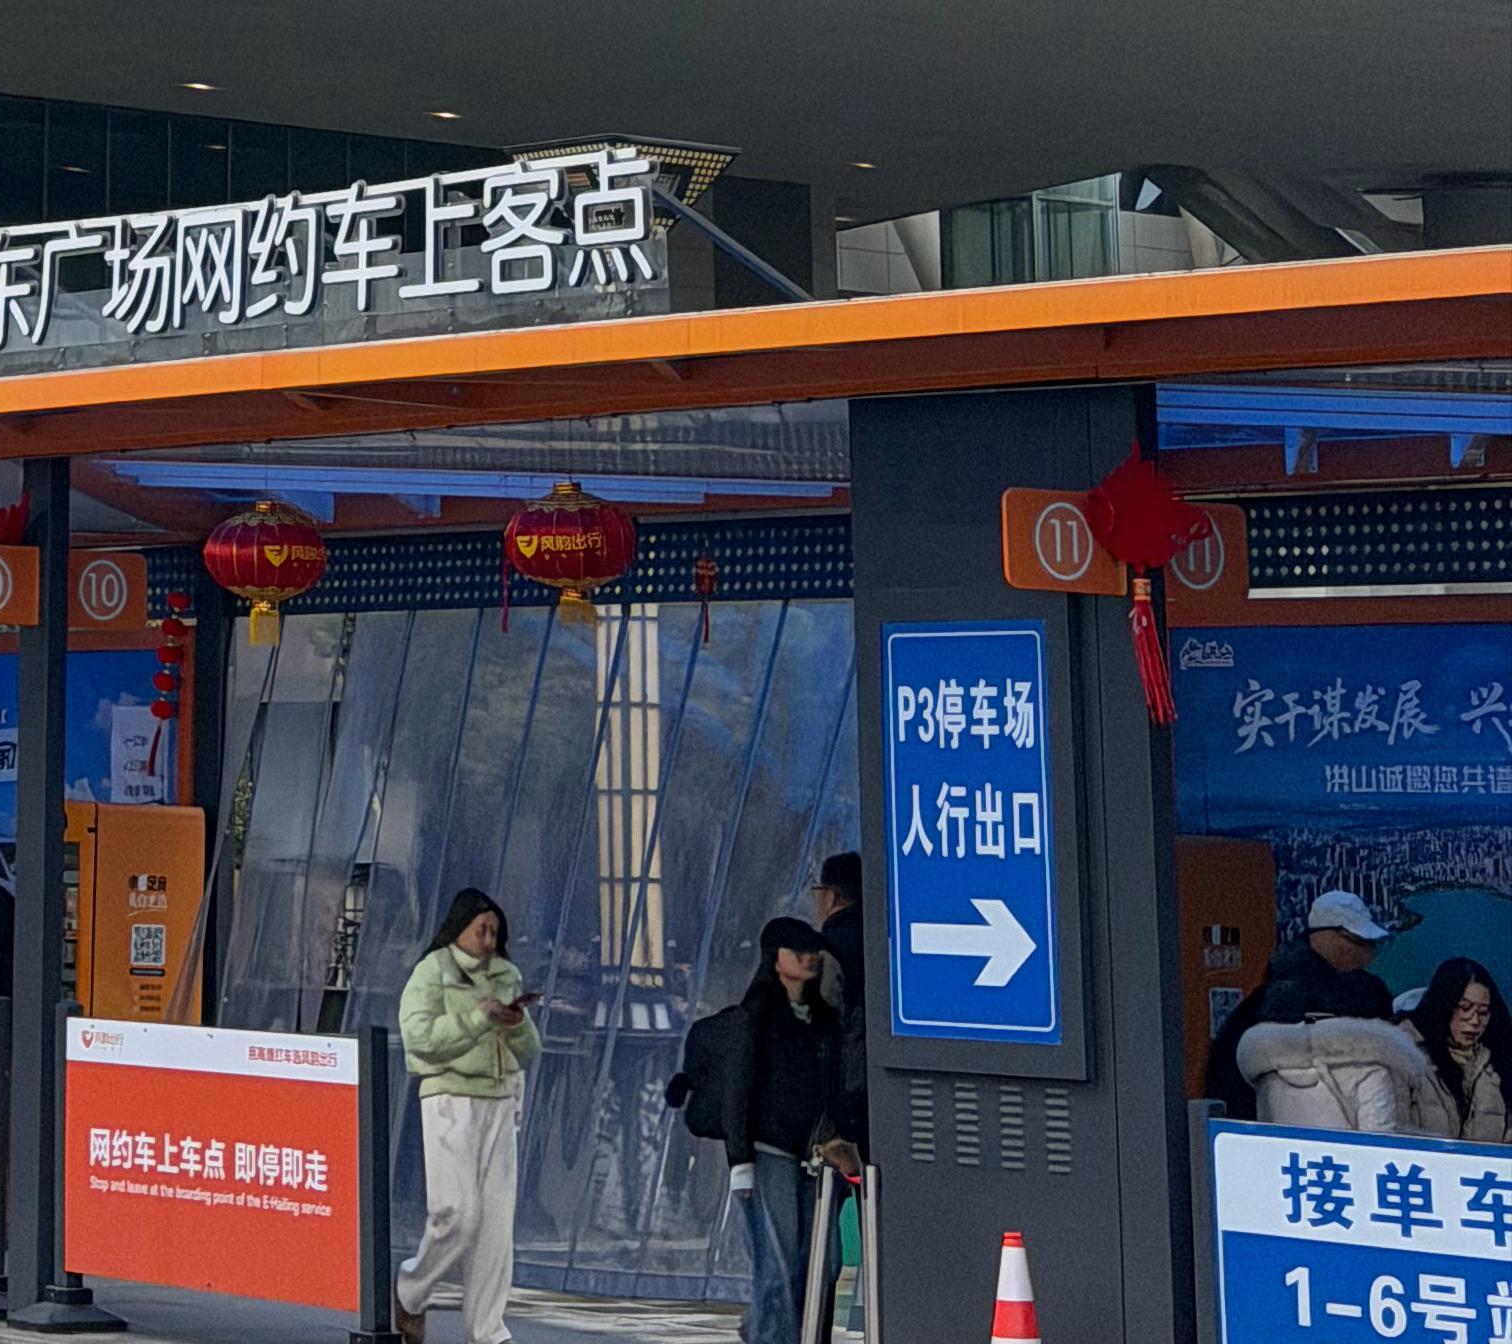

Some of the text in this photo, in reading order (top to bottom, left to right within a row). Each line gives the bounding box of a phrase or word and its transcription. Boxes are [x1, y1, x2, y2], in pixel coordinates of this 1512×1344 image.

[897, 678, 1035, 750] P3停车场
[1233, 677, 1440, 753] 实干谋发展
[901, 782, 1041, 860] 人行出口
[90, 1127, 328, 1192] 网约车上车点 即停即走
